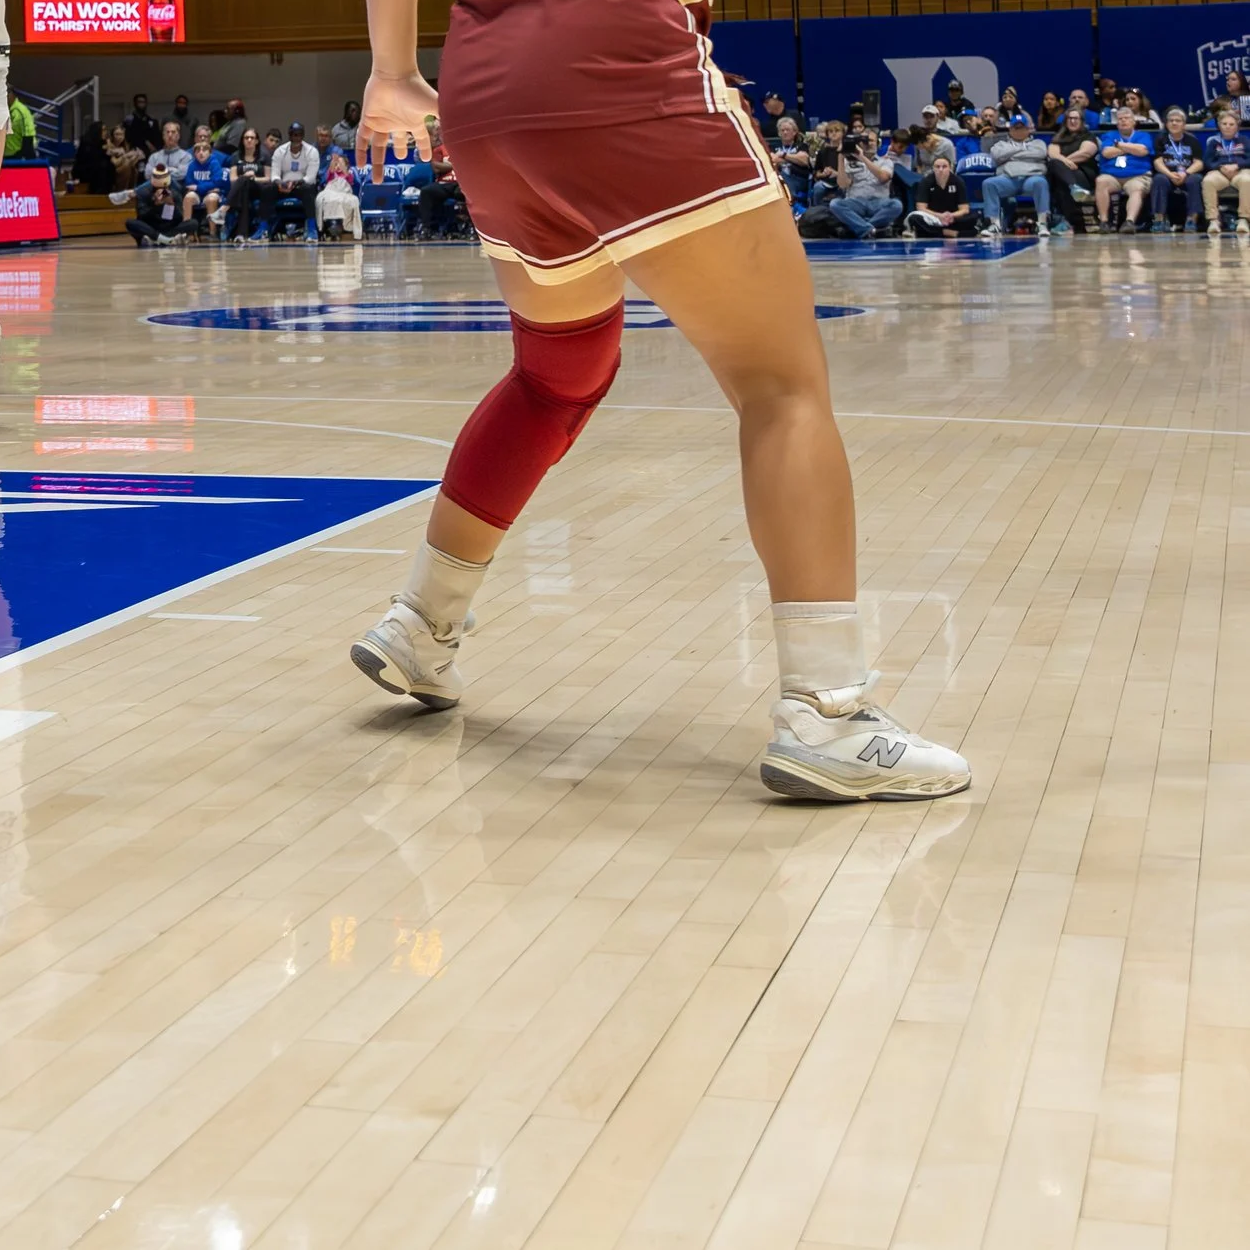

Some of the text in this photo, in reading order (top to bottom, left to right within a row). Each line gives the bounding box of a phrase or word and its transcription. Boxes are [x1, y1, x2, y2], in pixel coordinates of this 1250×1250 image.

[33, 1, 140, 20] FAN WORK
[33, 20, 141, 32] IS THIRSTY WORK
[965, 155, 992, 169] DUKE
